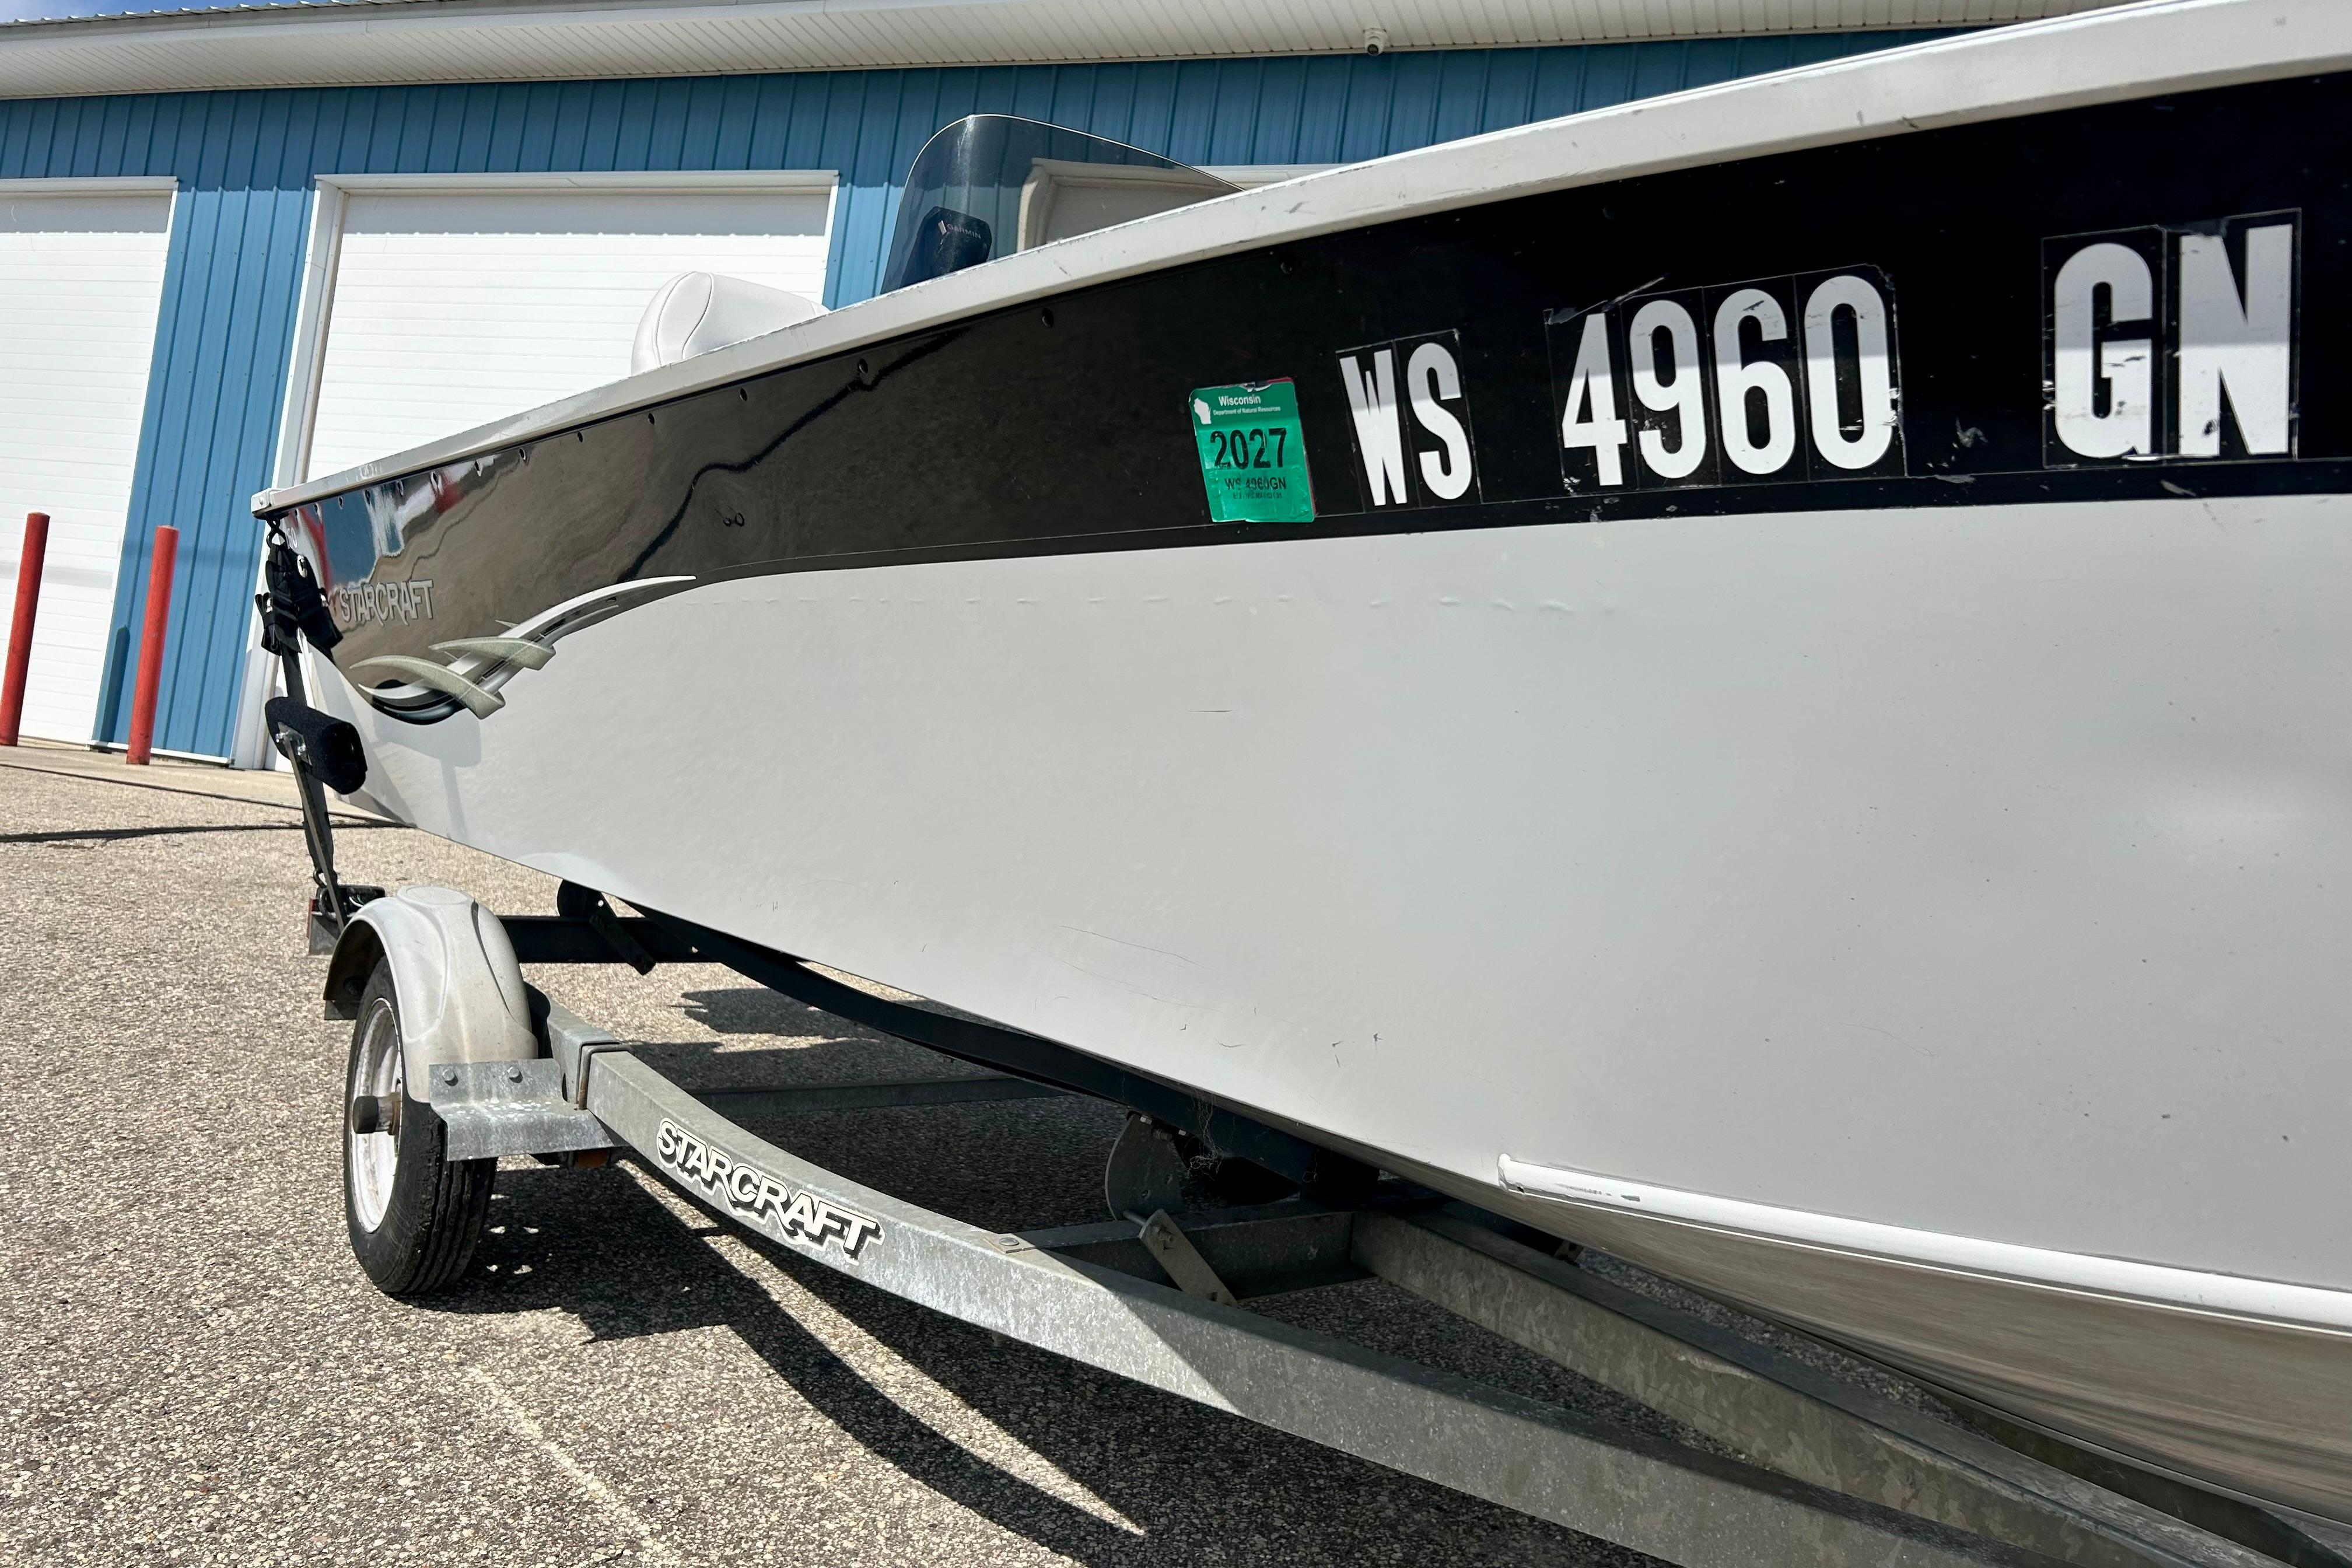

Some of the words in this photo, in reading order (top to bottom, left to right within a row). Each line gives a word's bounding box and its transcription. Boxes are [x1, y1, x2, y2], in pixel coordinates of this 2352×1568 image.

[947, 223, 981, 239] GARMIN
[1339, 342, 1473, 507] WS
[1561, 275, 1893, 486] 4960
[2054, 224, 2293, 459] GN
[1218, 394, 1261, 407] Wisconsin
[1210, 428, 1287, 470] 2027
[340, 579, 434, 626] STARCRAFT
[658, 1119, 884, 1261] STARCRAFT
